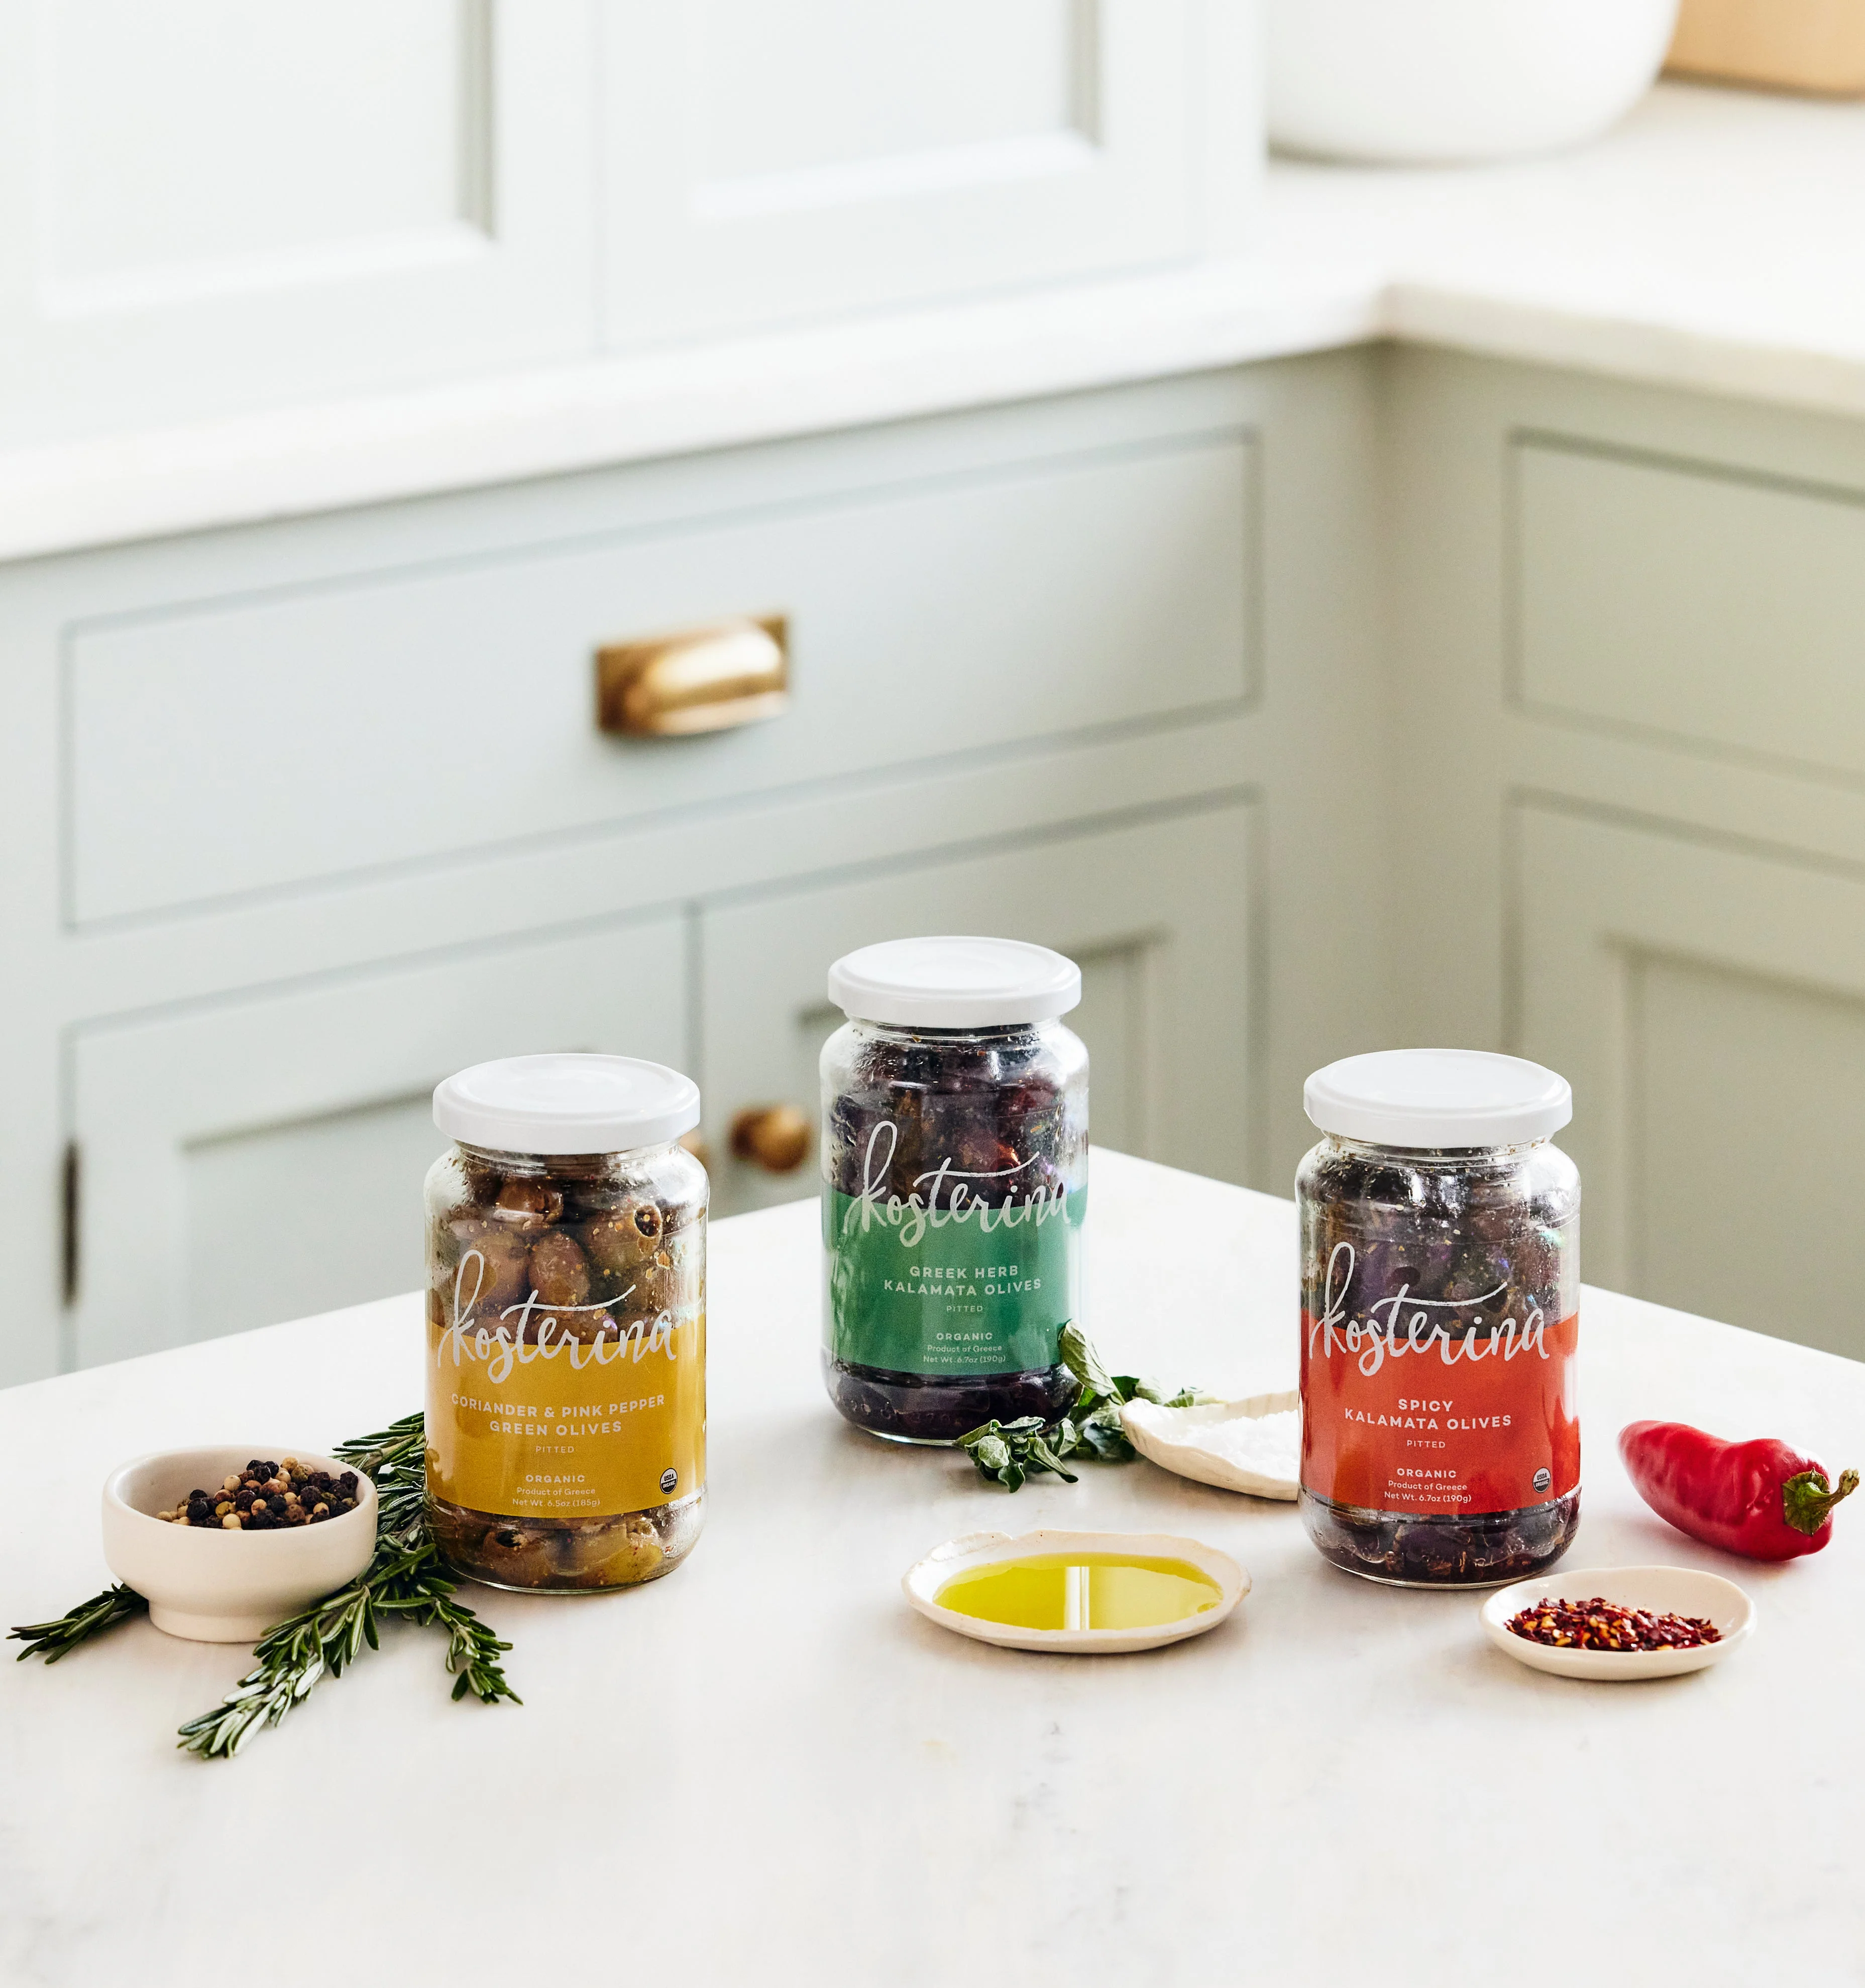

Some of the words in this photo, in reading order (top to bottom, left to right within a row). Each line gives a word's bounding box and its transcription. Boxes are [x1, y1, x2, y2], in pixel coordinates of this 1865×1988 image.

[843, 1121, 1071, 1247] kosterina
[910, 1266, 967, 1278] GREEK
[974, 1265, 1019, 1278] HERB
[884, 1279, 977, 1296] KALAMATA
[984, 1278, 1042, 1294] OLIVES
[1309, 1241, 1550, 1376] kosterina
[437, 1249, 677, 1384] kosterina
[936, 1332, 993, 1341] ORGANIC
[927, 1345, 960, 1353] Product
[923, 1355, 938, 1363] Net
[979, 1355, 1006, 1363] (190g)
[452, 1393, 537, 1418] CORIANDER
[544, 1406, 555, 1418] &
[562, 1404, 603, 1417] PINK
[609, 1394, 665, 1415] PEPPER
[1398, 1398, 1454, 1412] SPICY
[1345, 1408, 1438, 1430] KALAMATA
[1447, 1414, 1511, 1429] OLIVES
[490, 1421, 547, 1435] GREEN
[556, 1421, 621, 1435] OLIVES
[1406, 1440, 1446, 1448] PITTED
[525, 1474, 586, 1483] ORGANIC
[1396, 1468, 1457, 1478] ORGANIC
[517, 1487, 551, 1495] Product
[1388, 1480, 1422, 1490] Product
[572, 1498, 601, 1507] (185g)
[1384, 1491, 1399, 1499] Net
[1443, 1494, 1472, 1503] (190g)
